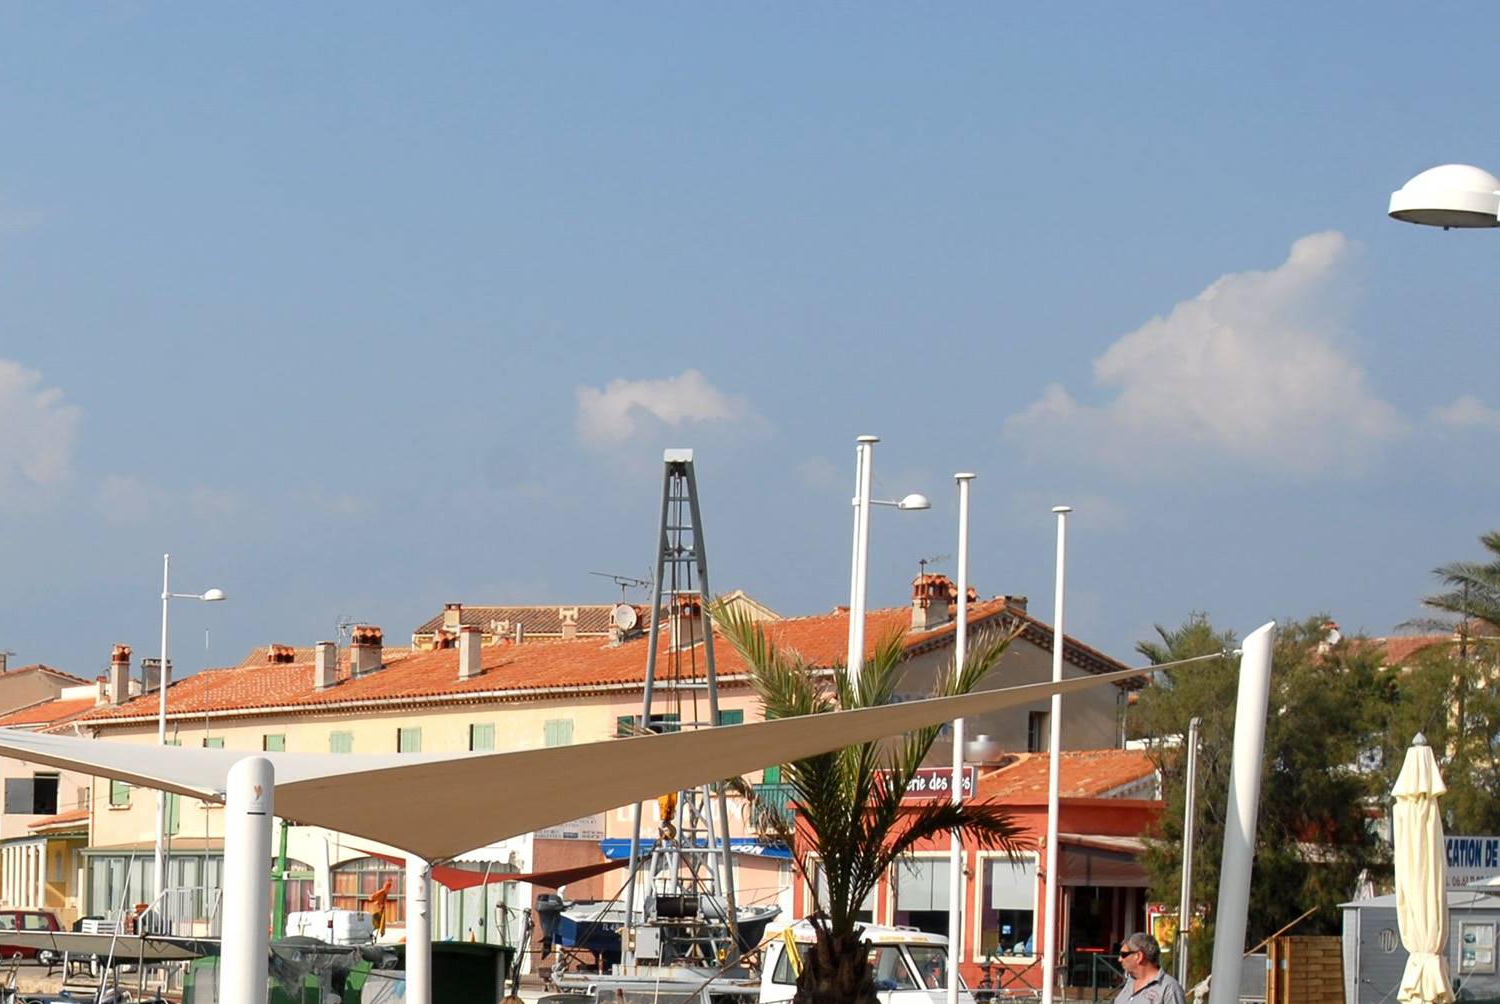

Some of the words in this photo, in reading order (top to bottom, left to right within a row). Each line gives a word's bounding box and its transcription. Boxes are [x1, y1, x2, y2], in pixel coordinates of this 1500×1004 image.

[929, 772, 948, 790] des
[1444, 838, 1482, 867] CATION
[1485, 839, 1498, 867] DE
